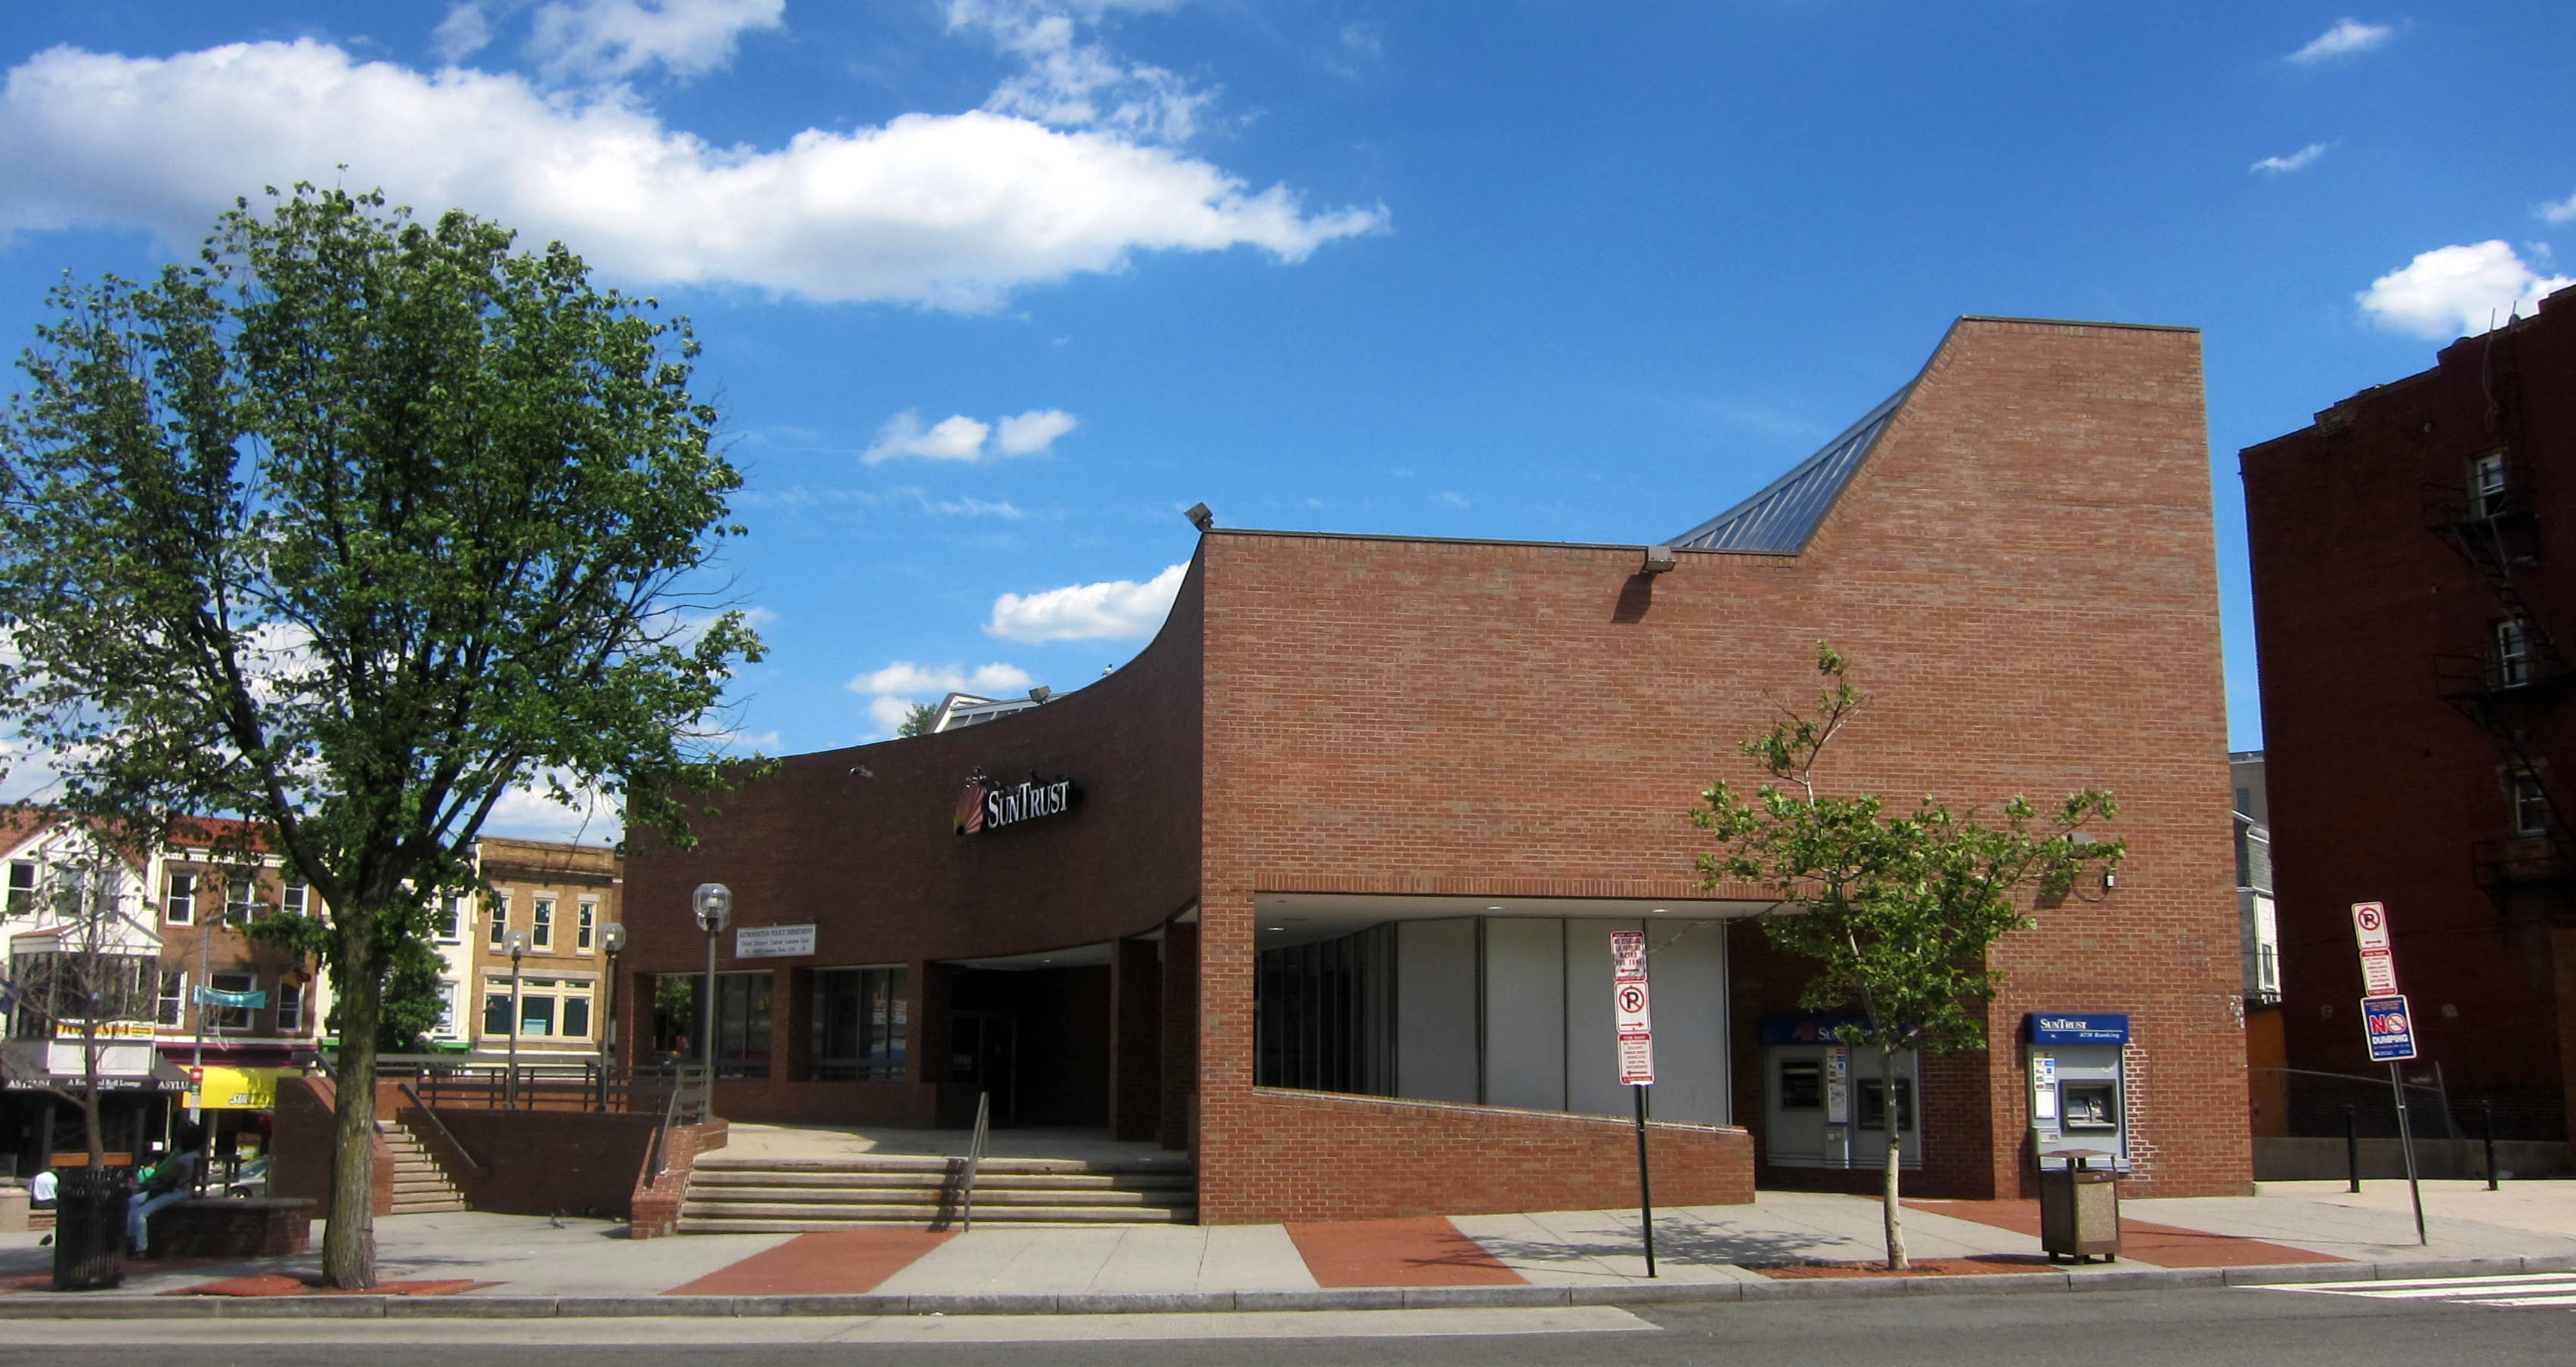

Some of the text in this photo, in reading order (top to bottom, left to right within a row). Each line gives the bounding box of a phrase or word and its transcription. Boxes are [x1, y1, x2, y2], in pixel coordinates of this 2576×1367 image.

[988, 781, 1069, 828] SUNTRUST
[1627, 992, 1639, 1009] P
[2040, 1018, 2087, 1029] SUNTRUST
[157, 1080, 189, 1090] ASYLU
